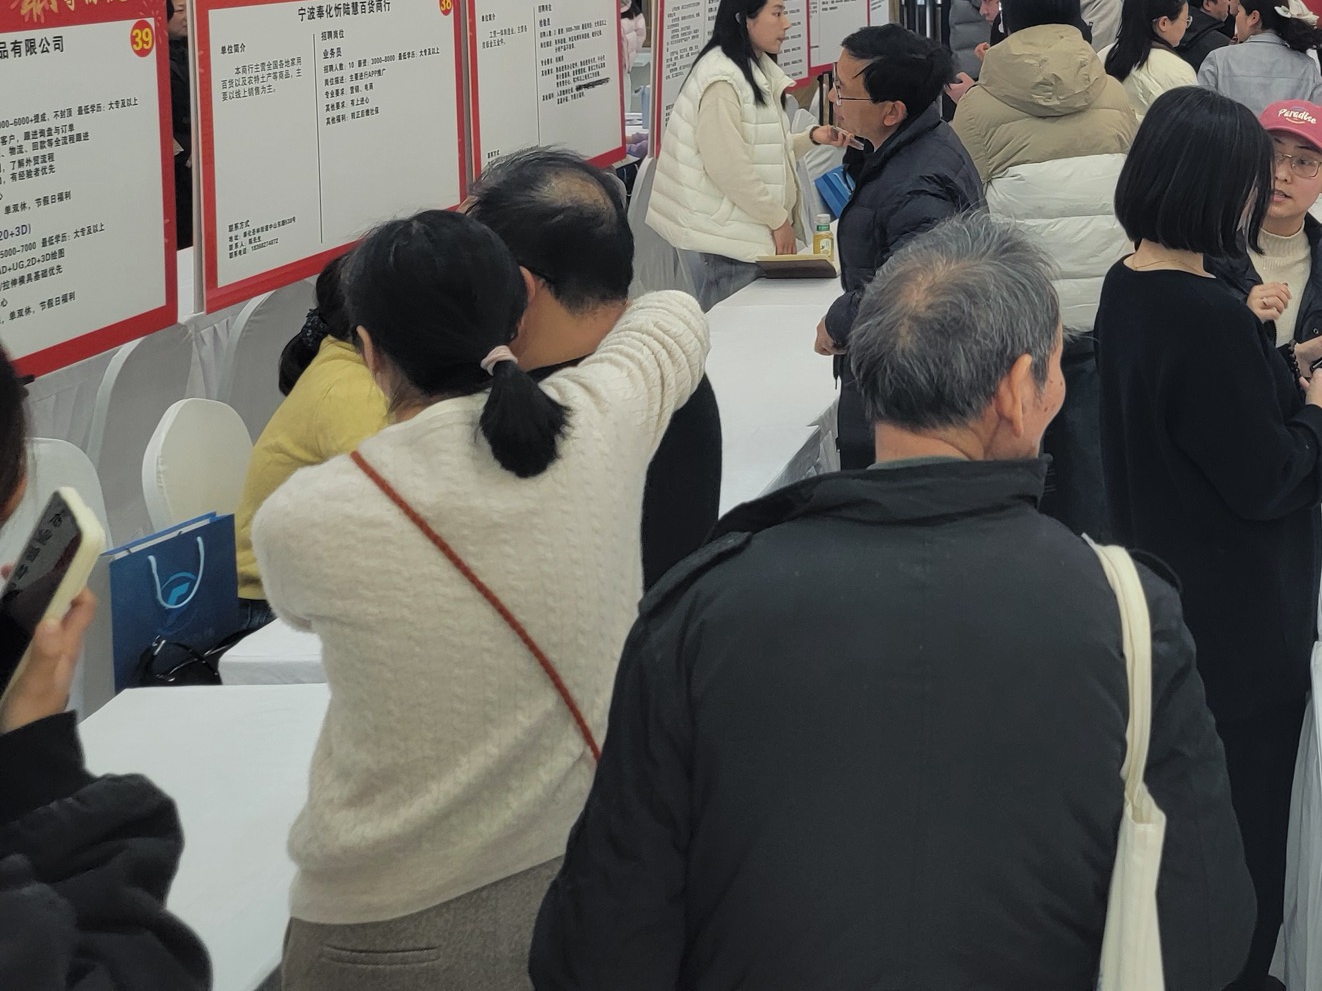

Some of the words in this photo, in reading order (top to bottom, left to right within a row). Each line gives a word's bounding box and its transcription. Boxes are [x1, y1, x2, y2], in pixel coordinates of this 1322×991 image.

[132, 28, 152, 51] 39
[321, 29, 345, 42] 招聘岗位
[221, 43, 246, 55] 单位简介
[322, 47, 342, 60] 业务员
